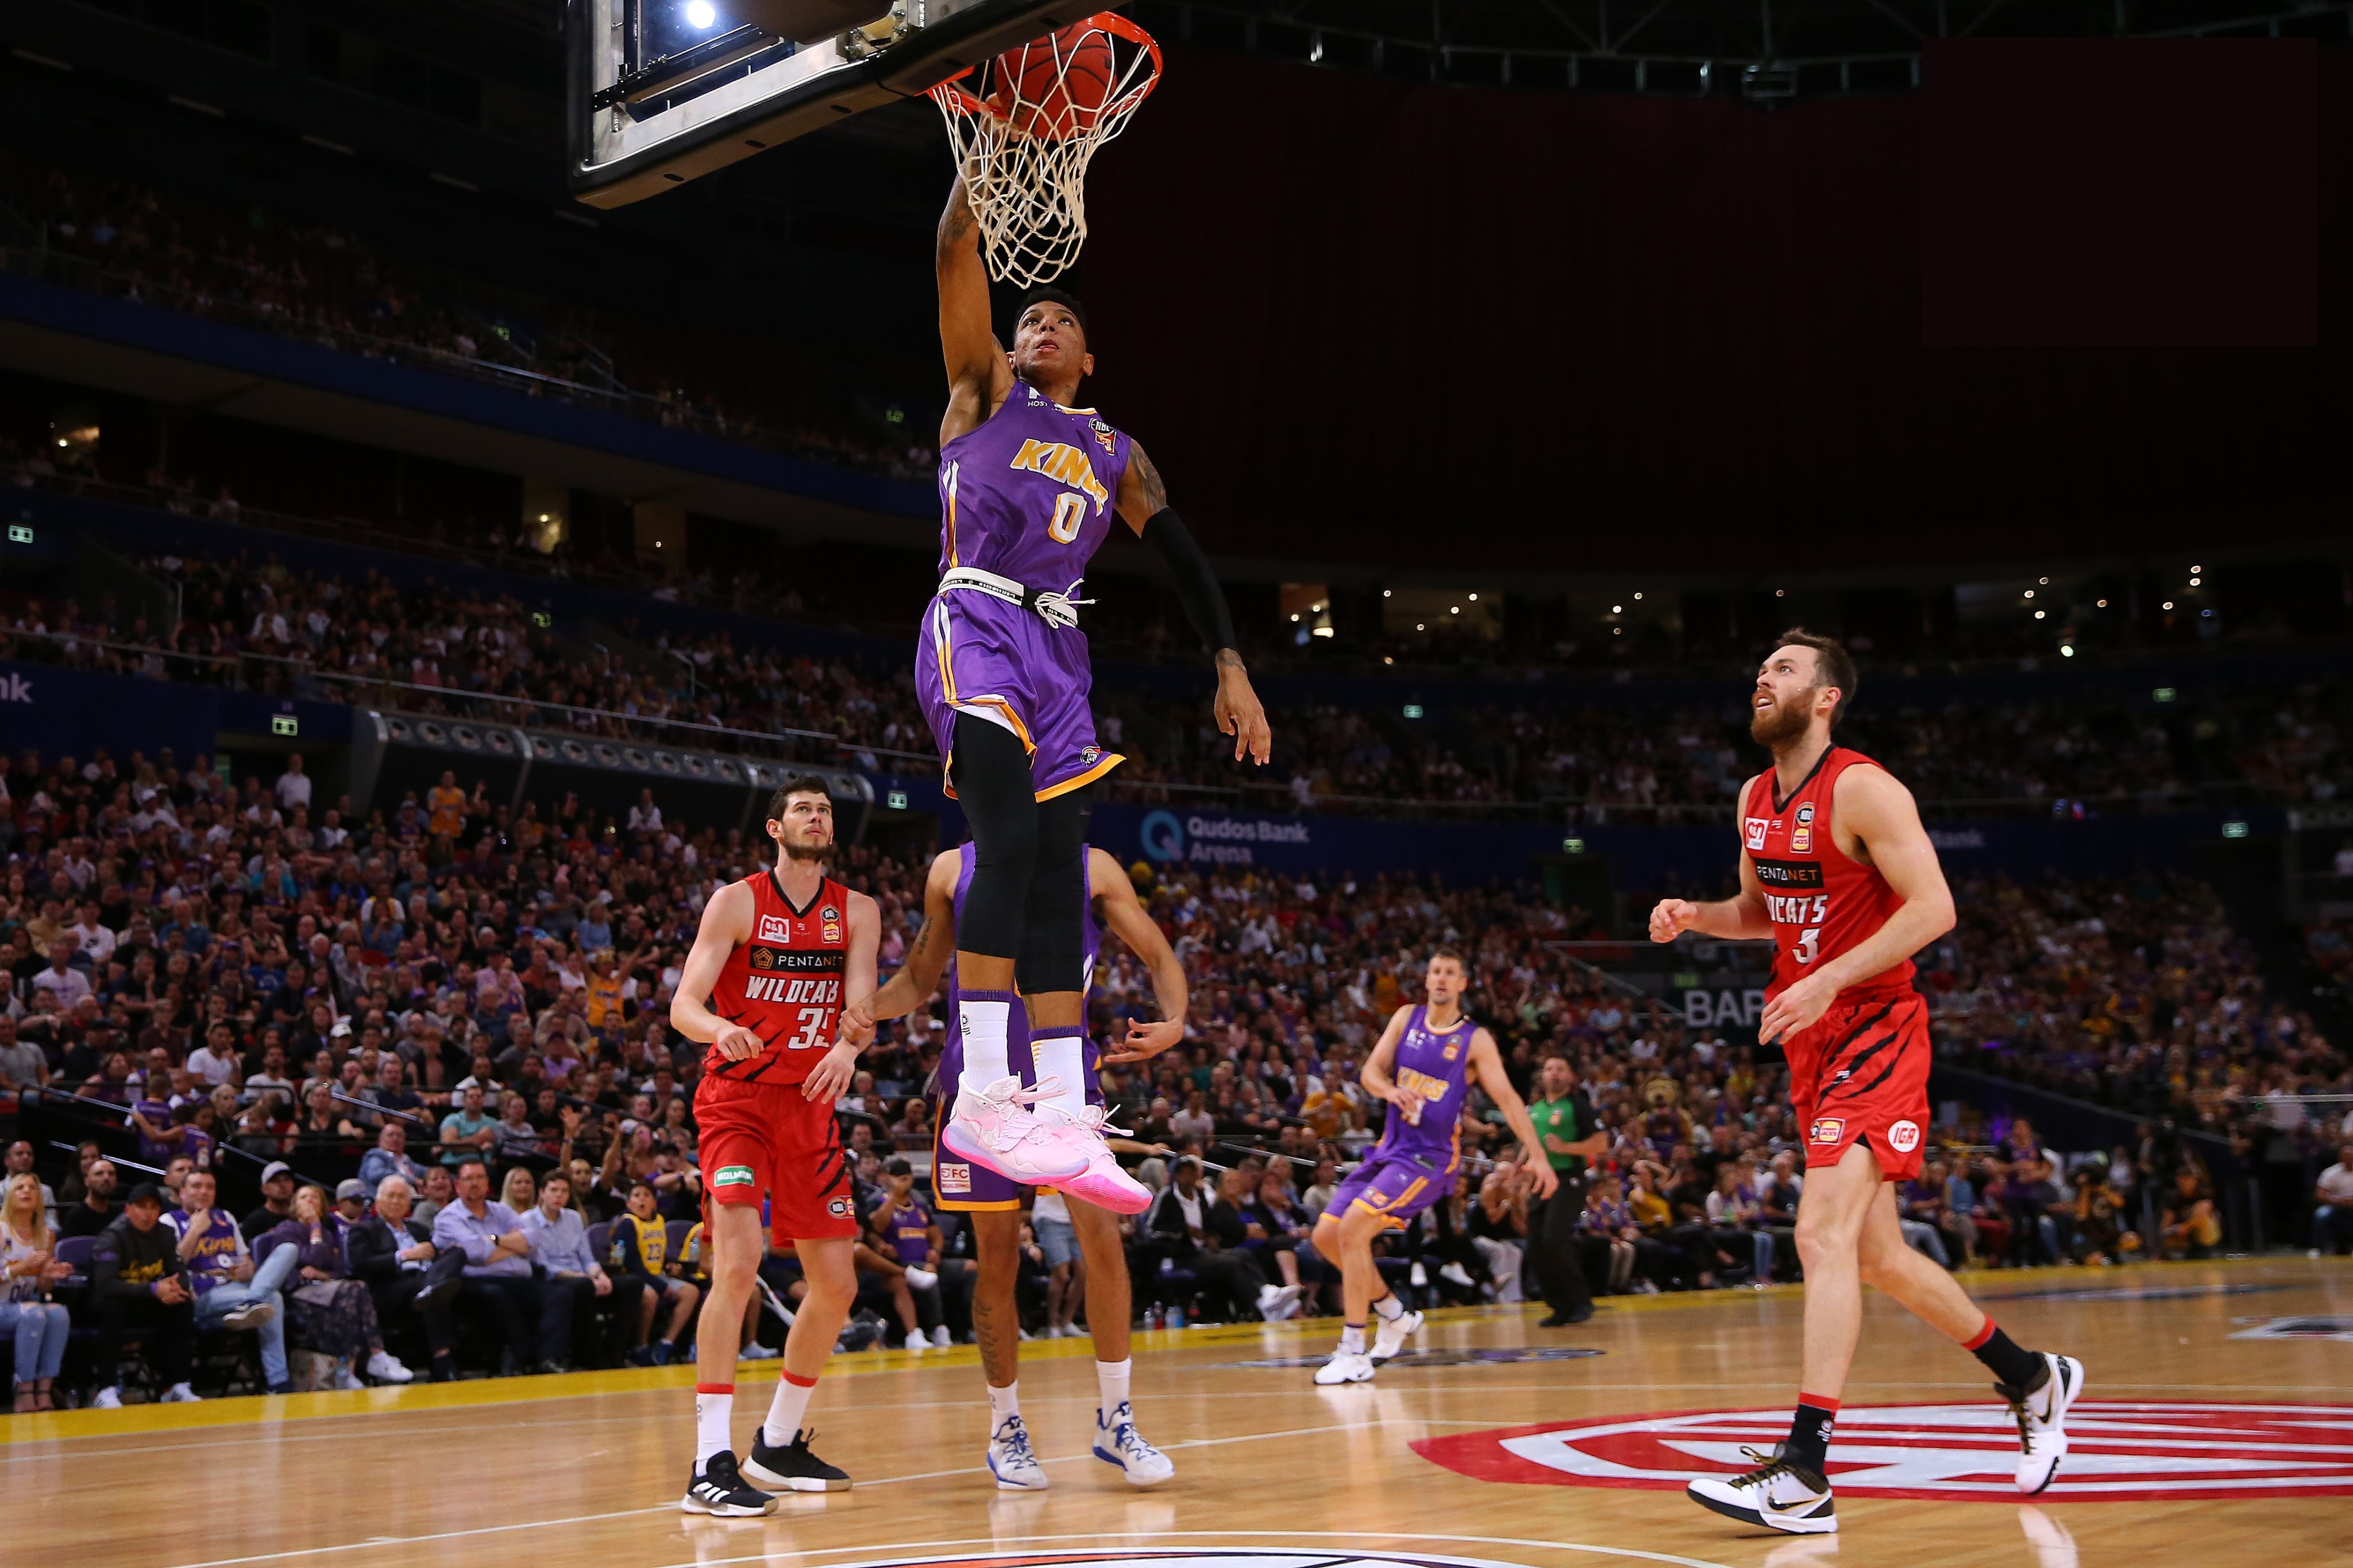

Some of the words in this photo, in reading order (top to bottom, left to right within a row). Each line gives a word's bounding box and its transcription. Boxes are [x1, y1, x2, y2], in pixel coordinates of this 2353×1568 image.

[1047, 492, 1087, 544] 0
[1187, 816, 1256, 840] Qudos
[1258, 821, 1309, 843] Bank
[1190, 841, 1253, 863] Arena
